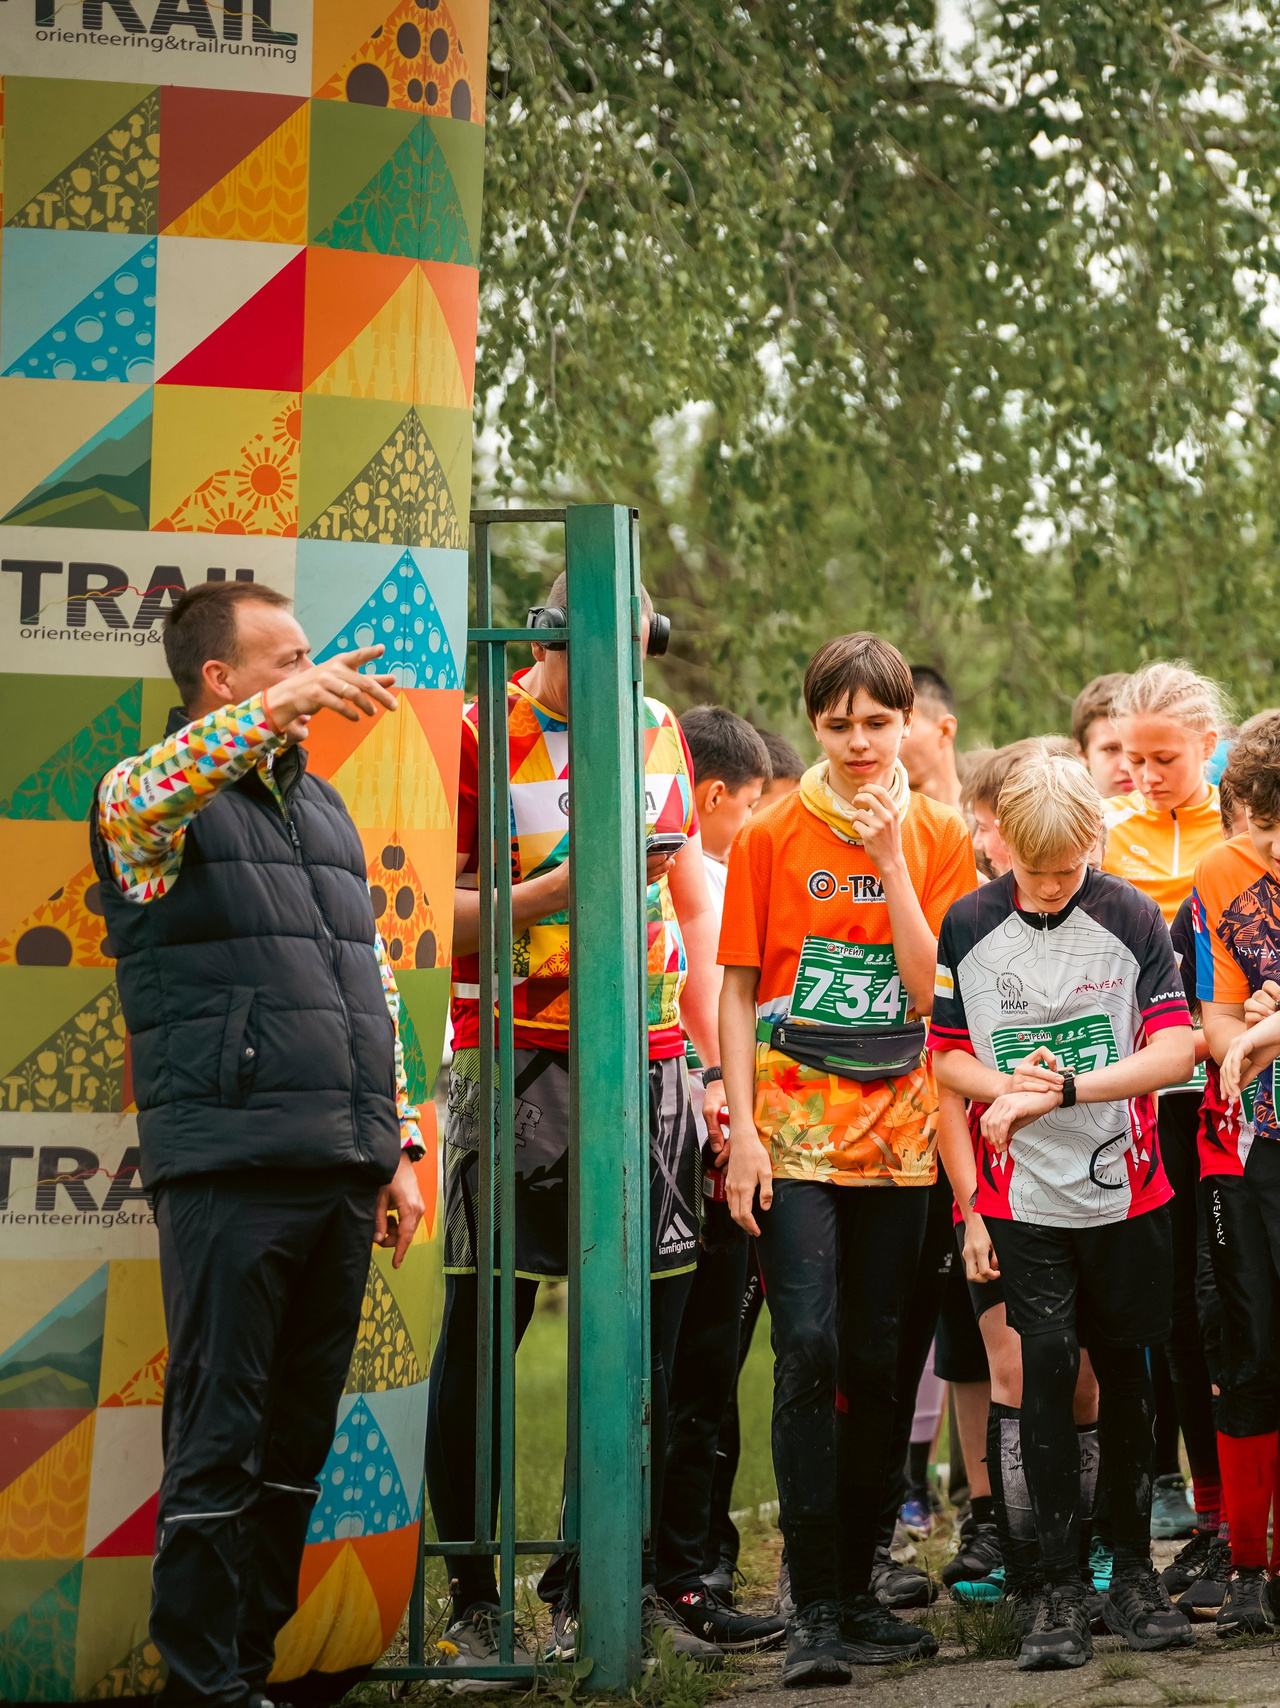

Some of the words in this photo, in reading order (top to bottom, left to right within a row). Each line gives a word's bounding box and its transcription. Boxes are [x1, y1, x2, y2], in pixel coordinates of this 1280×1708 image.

[35, 29, 298, 63] orienteering&trailrunning
[2, 559, 255, 629] TRA
[20, 628, 162, 647] orienteering&
[799, 966, 902, 1019] 734
[1000, 999, 1029, 1010] ИКАР
[0, 1144, 155, 1212] TRA
[658, 1238, 697, 1256] iamfighter
